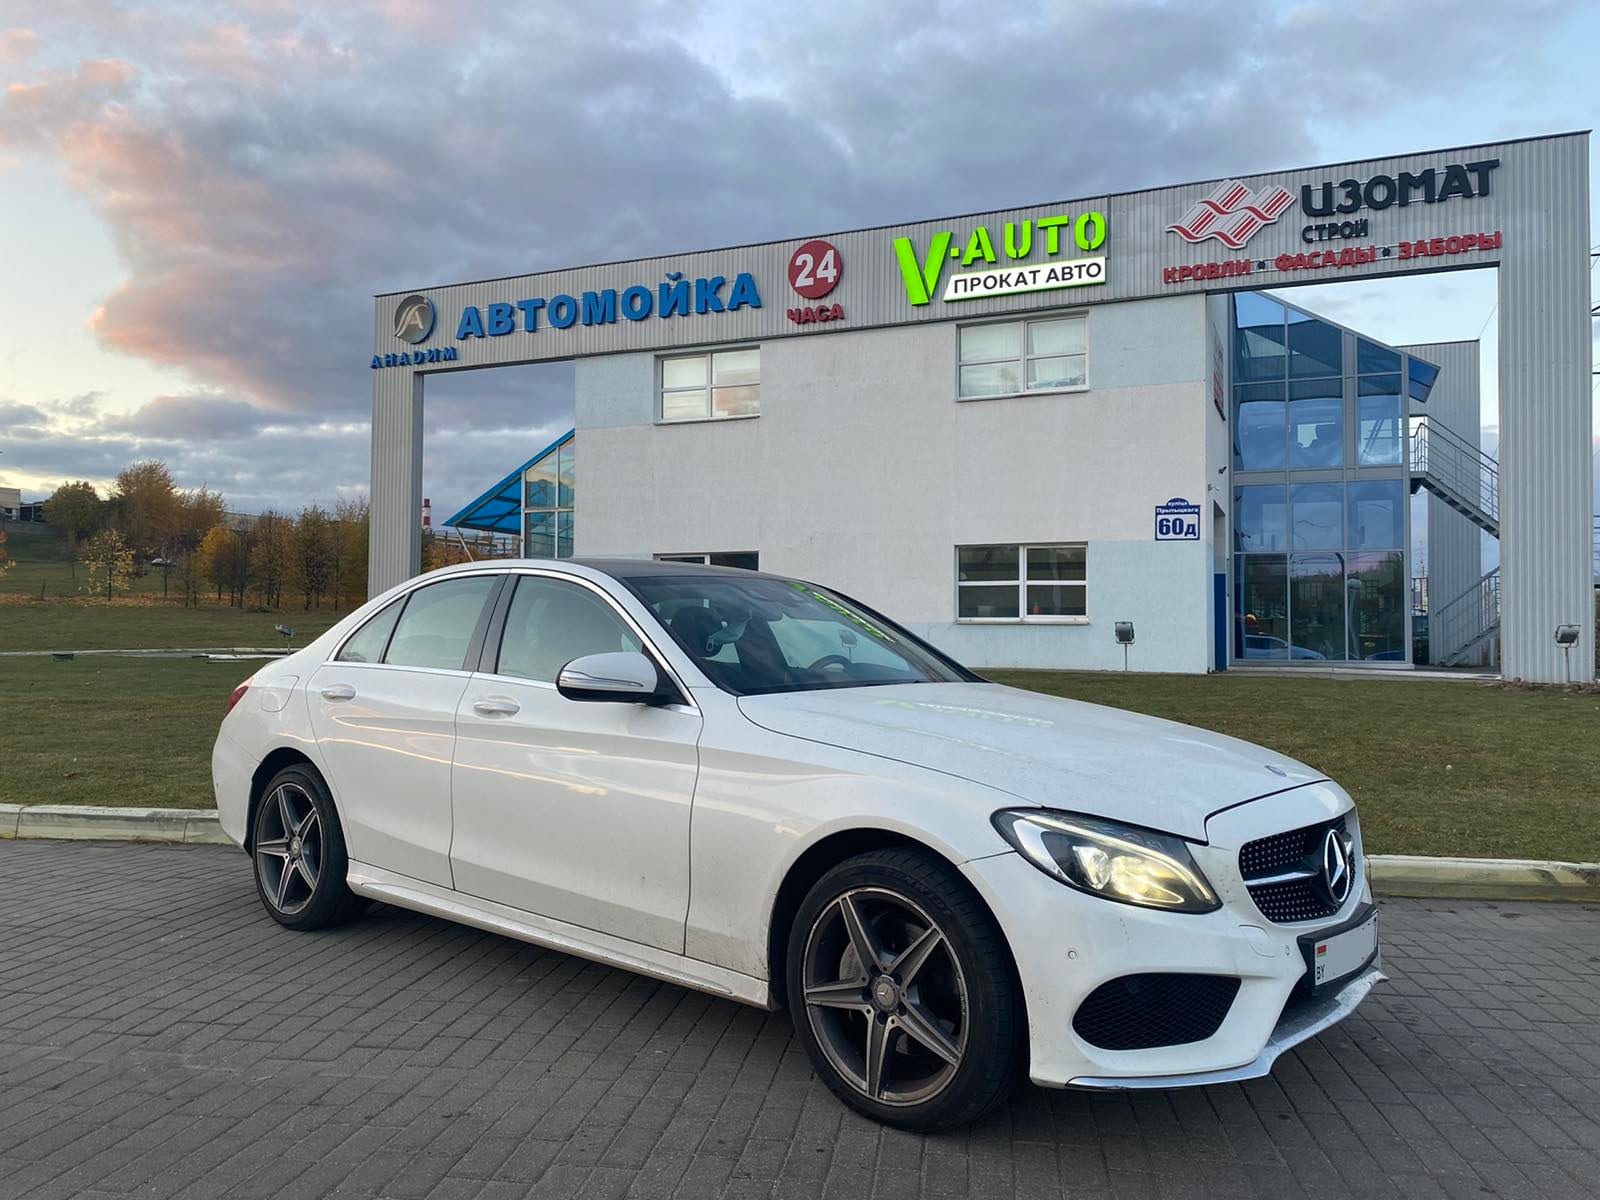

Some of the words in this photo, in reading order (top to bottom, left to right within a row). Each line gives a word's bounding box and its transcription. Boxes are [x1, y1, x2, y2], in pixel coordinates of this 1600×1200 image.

[1302, 218, 1368, 244] СТРОЙ
[795, 249, 837, 288] 24
[893, 211, 1106, 305] V-AUTO
[1163, 259, 1252, 284] КРОВЛИ
[1275, 245, 1376, 271] ФАСАДЫ
[1398, 231, 1502, 260] ЗАБОРЫ
[953, 269, 1041, 293] ПРОКАТ
[1045, 262, 1102, 283] АВТО
[455, 272, 762, 340] АВТОМОЙКА
[787, 304, 845, 325] ЧАСА
[1316, 964, 1325, 980] BY
